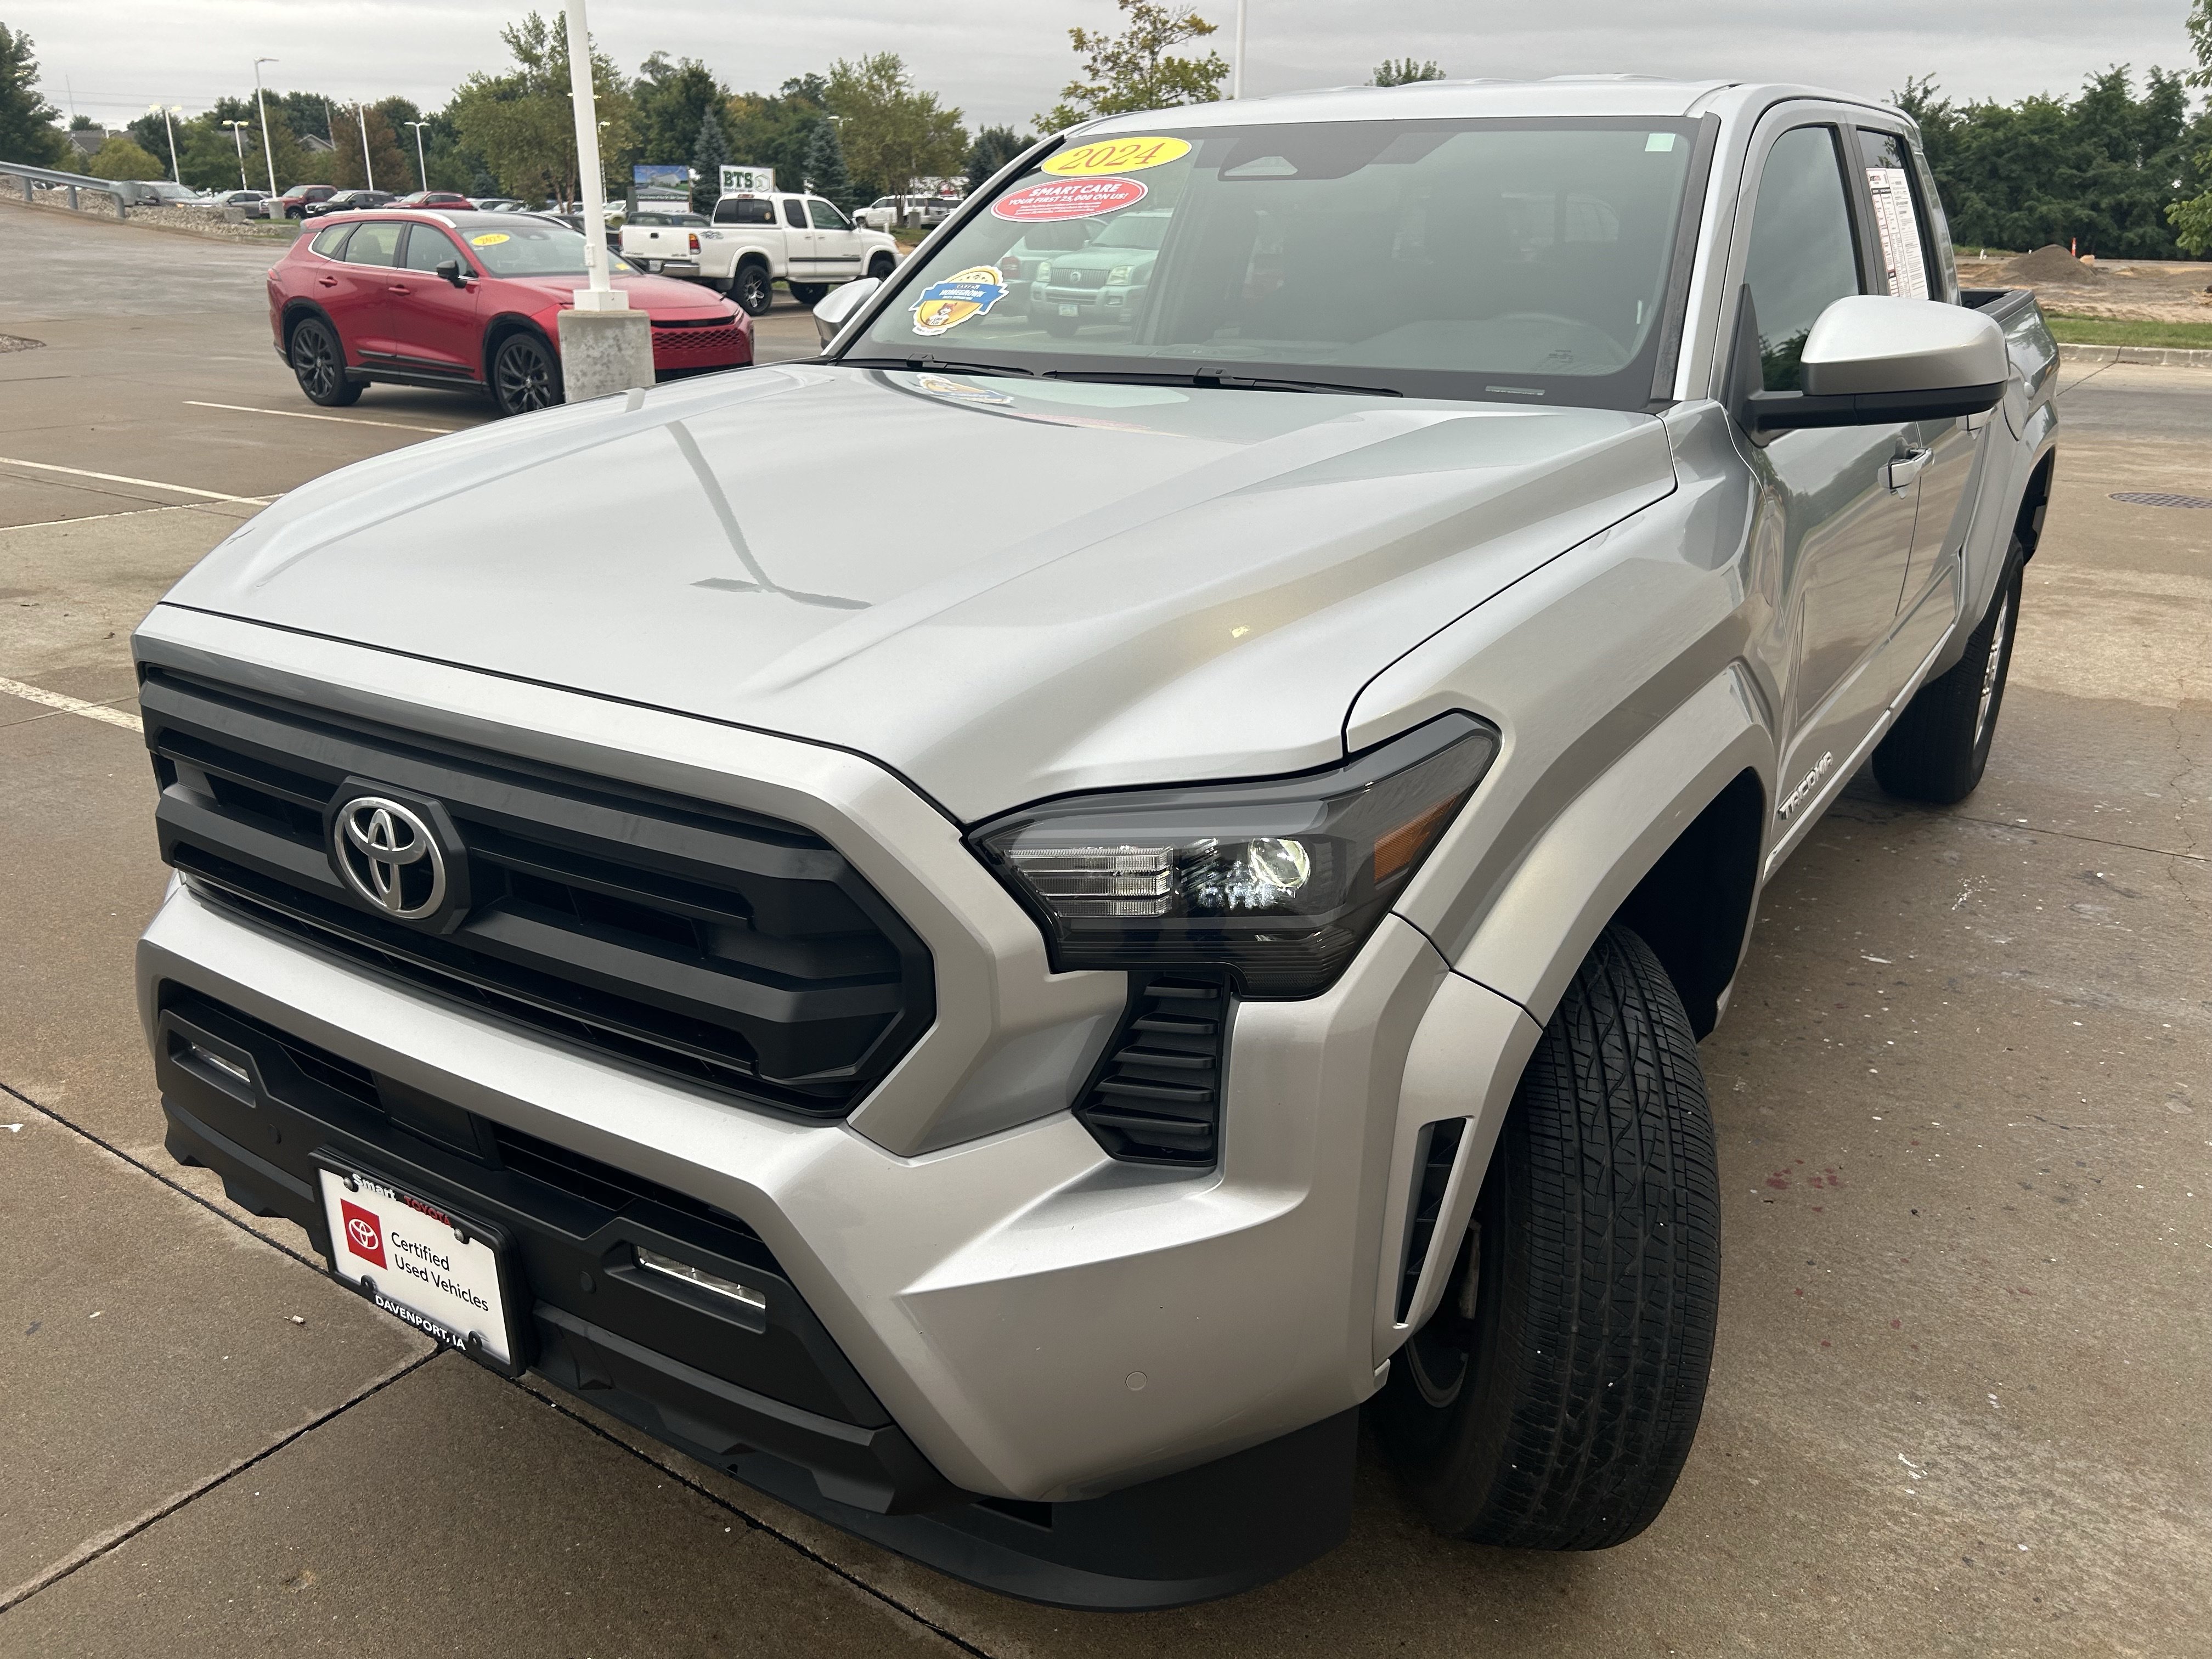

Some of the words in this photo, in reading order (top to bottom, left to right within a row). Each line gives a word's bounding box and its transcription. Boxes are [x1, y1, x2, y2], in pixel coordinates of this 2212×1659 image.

[1057, 143, 1165, 170] 2024
[723, 171, 753, 188] BTS
[1028, 185, 1081, 197] SMART
[1080, 184, 1122, 193] CARE
[1058, 194, 1091, 202] 25,000
[1778, 751, 1833, 820] TACOMA
[352, 1173, 397, 1201] Smart
[404, 1195, 452, 1227] TOYOTA
[391, 1232, 450, 1272] Certified
[394, 1254, 429, 1283] Used
[432, 1273, 489, 1312] Vehicles
[375, 1295, 450, 1343] DAVENPORT,
[453, 1335, 466, 1351] IA
